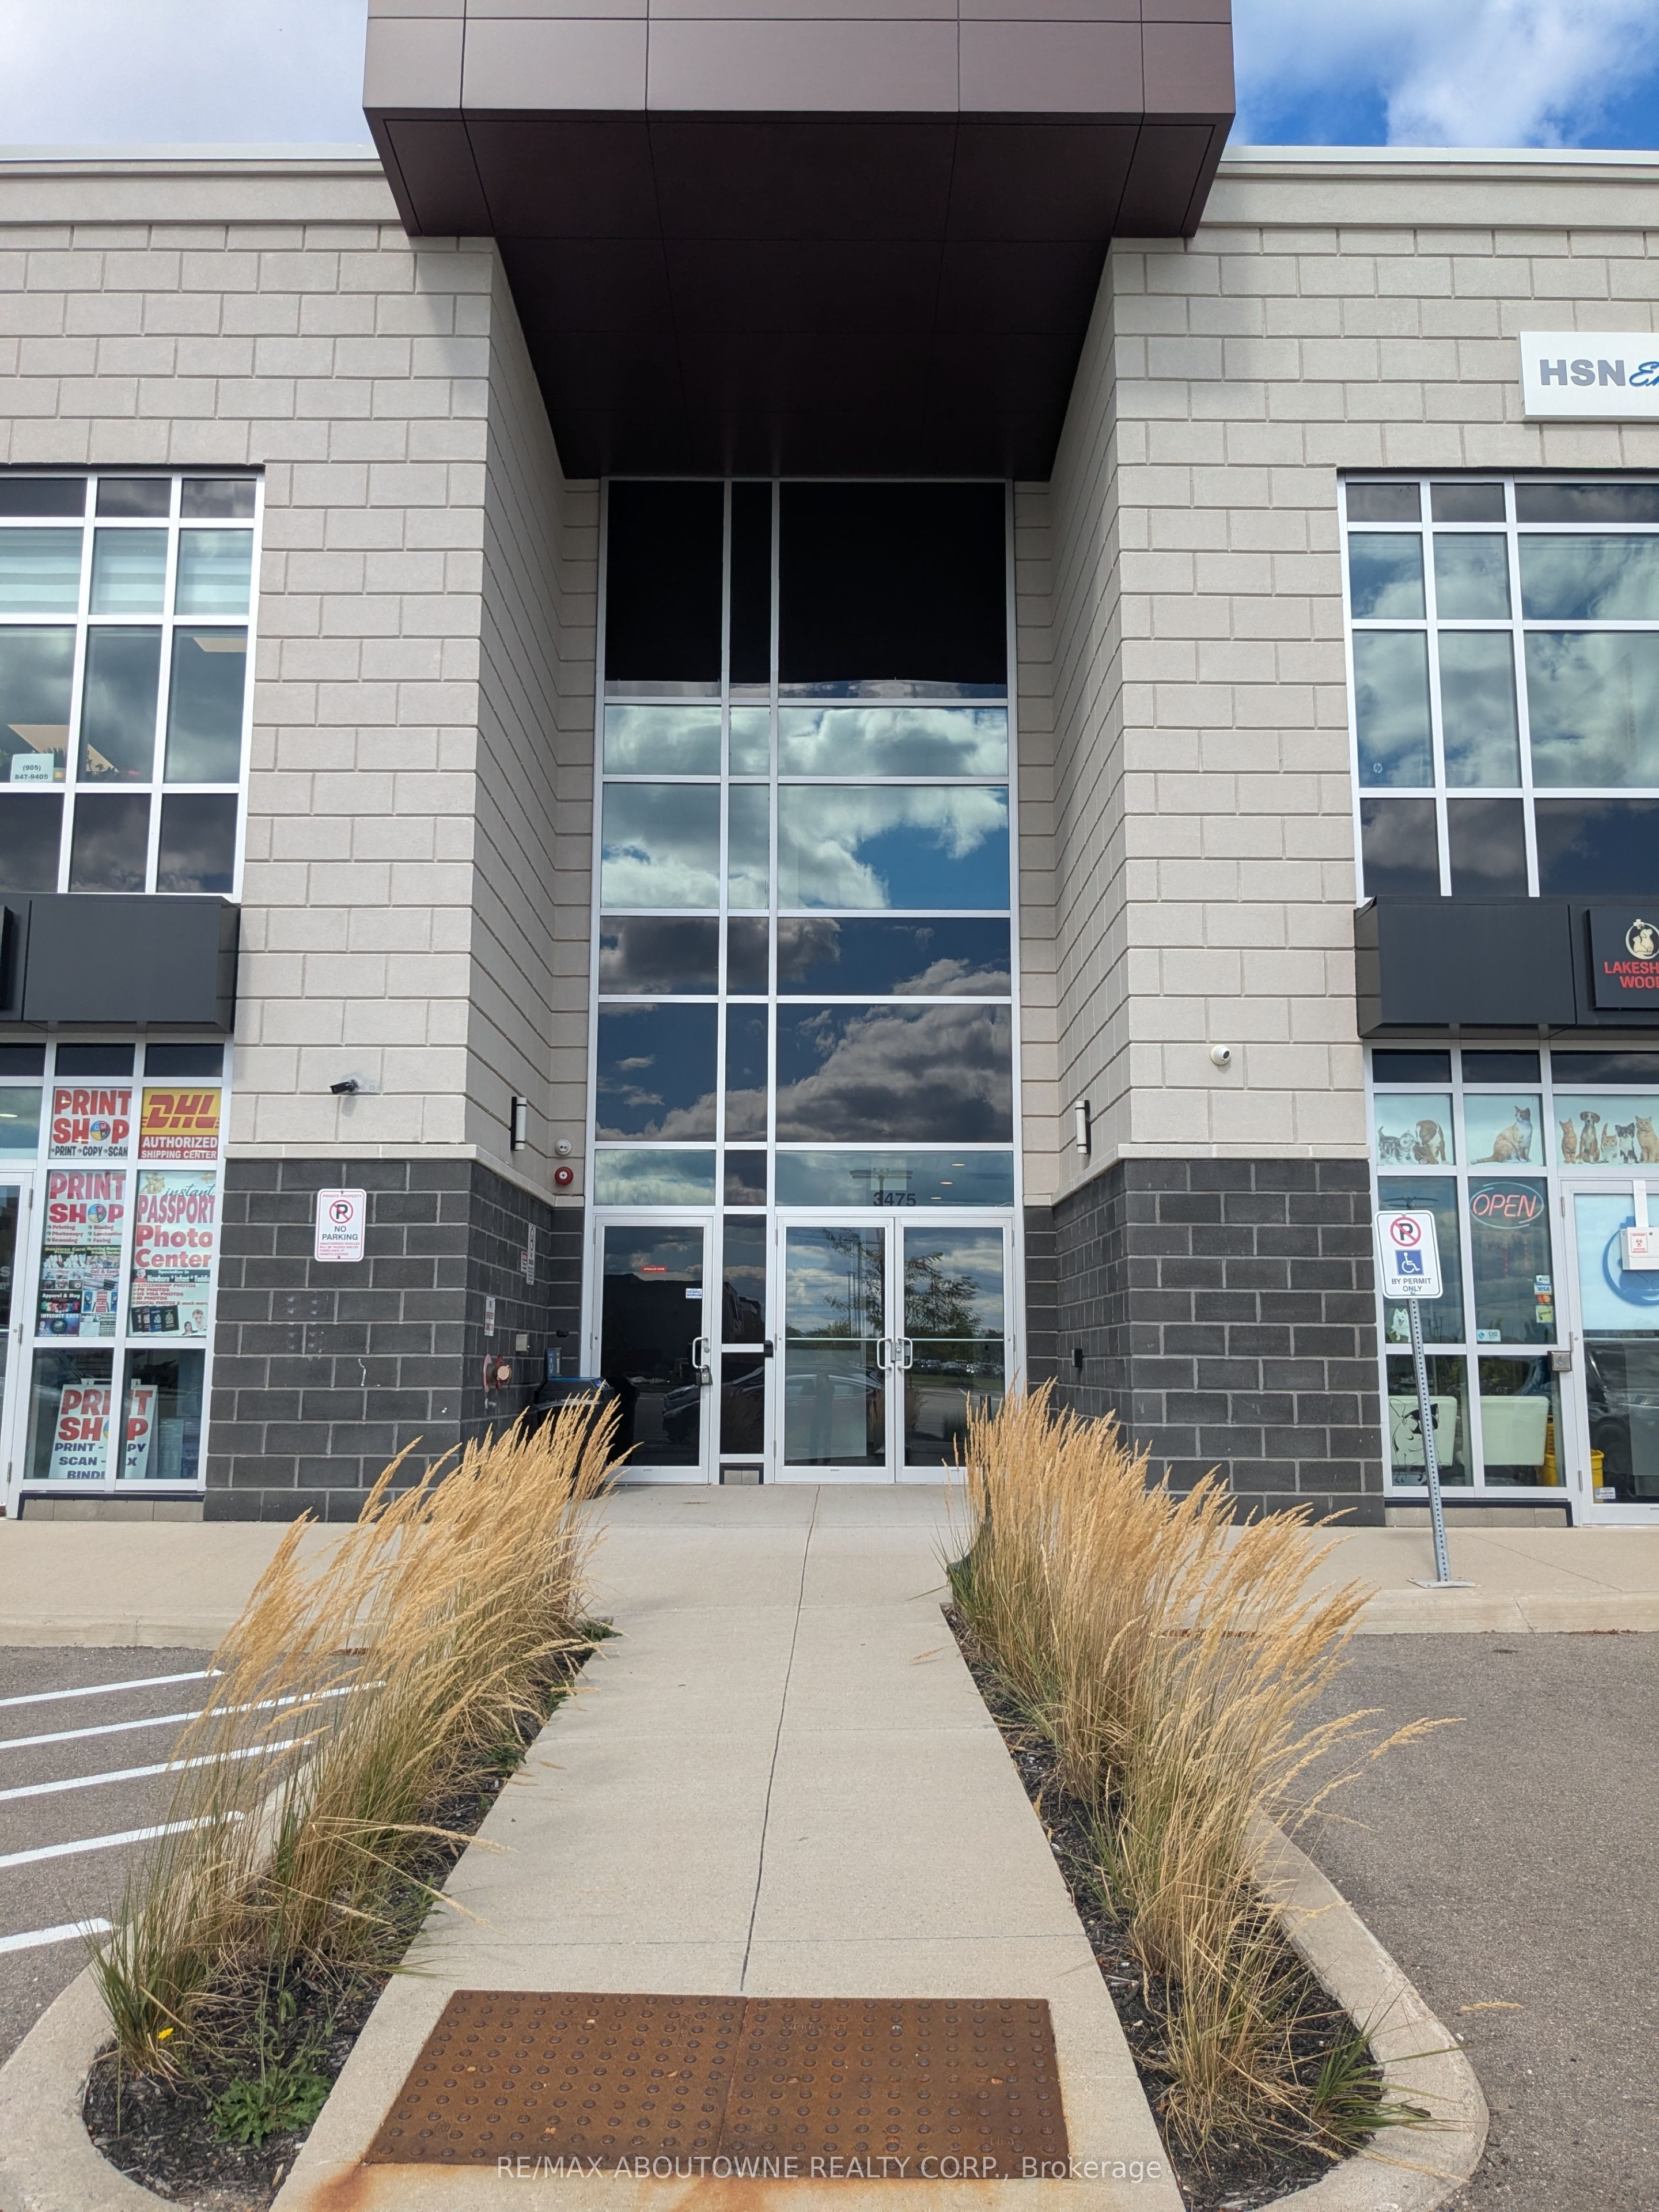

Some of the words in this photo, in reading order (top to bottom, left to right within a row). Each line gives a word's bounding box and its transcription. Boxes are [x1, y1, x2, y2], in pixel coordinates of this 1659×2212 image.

[1539, 359, 1626, 386] HSN
[54, 1089, 132, 1115] PRINT
[146, 1094, 218, 1128] DHL
[55, 1146, 77, 1156] PRINT
[82, 1146, 103, 1156] COPY
[108, 1146, 128, 1157] SCAN
[142, 1137, 217, 1147] AUTHORIZED
[141, 1150, 181, 1158] SHIPPING
[184, 1150, 217, 1158] CENTER
[50, 1171, 126, 1201] PRINT
[165, 1183, 216, 1197] instant
[137, 1195, 216, 1224] PASSPORT
[873, 1192, 916, 1206] 3475
[1473, 1194, 1536, 1217] OPEN
[135, 1225, 213, 1248] Photo
[135, 1248, 212, 1267] Center
[60, 1389, 154, 1415] PRIT
[54, 1442, 96, 1451] PRINT
[59, 1457, 98, 1465] SCAN
